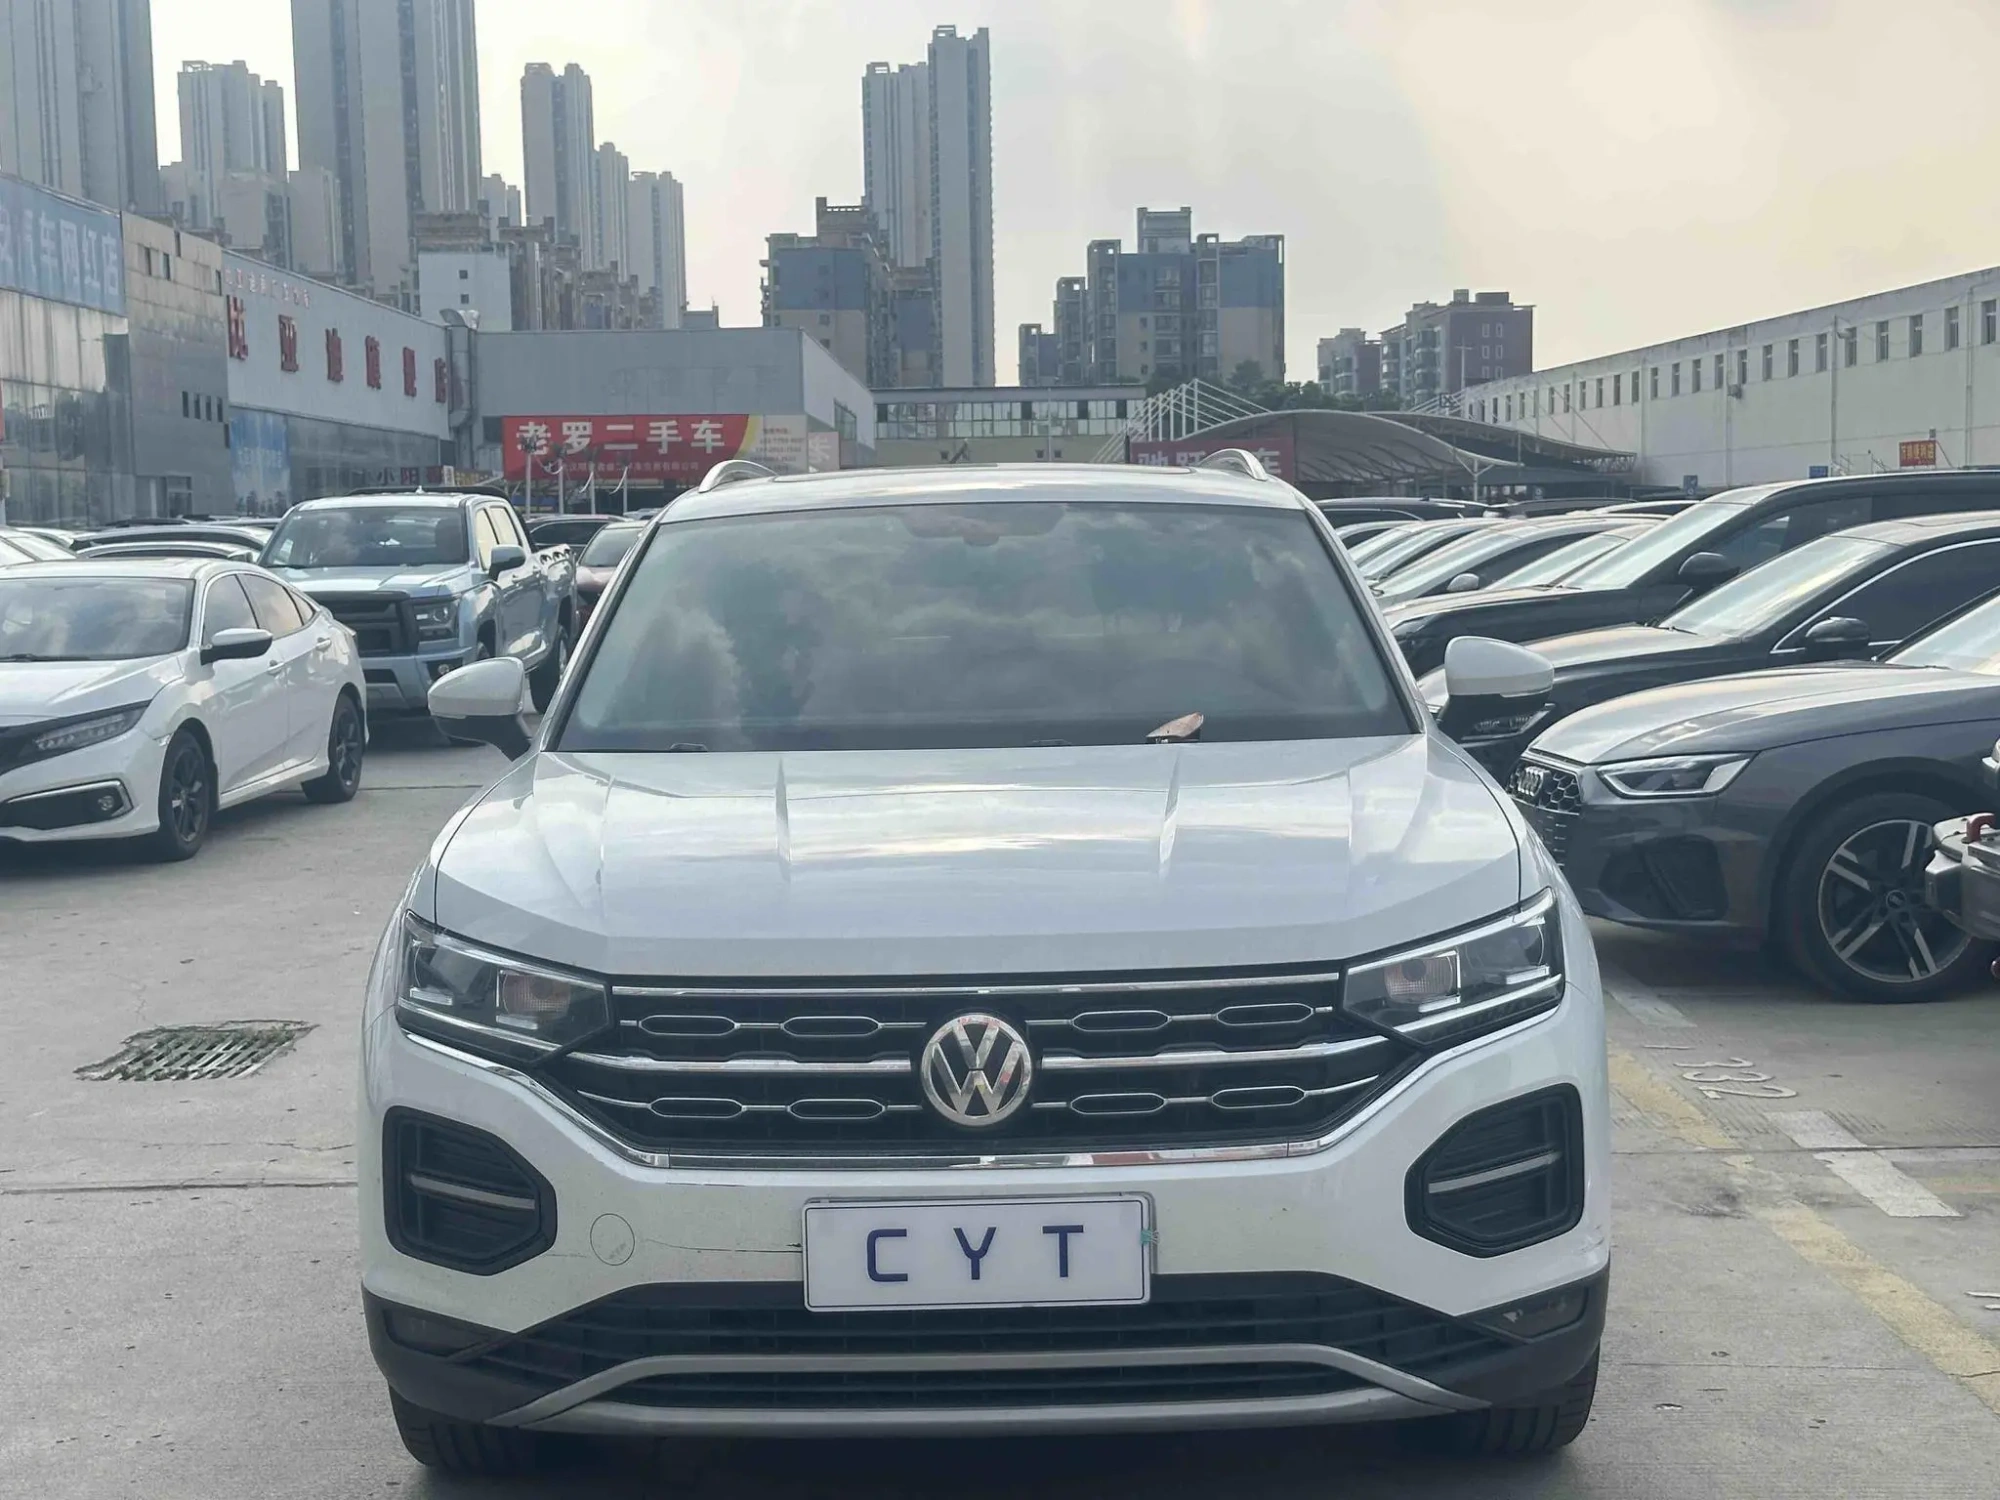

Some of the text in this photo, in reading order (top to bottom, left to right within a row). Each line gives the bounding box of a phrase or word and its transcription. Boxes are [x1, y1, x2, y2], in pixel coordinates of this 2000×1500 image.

[516, 420, 725, 456] 老罗二手车
